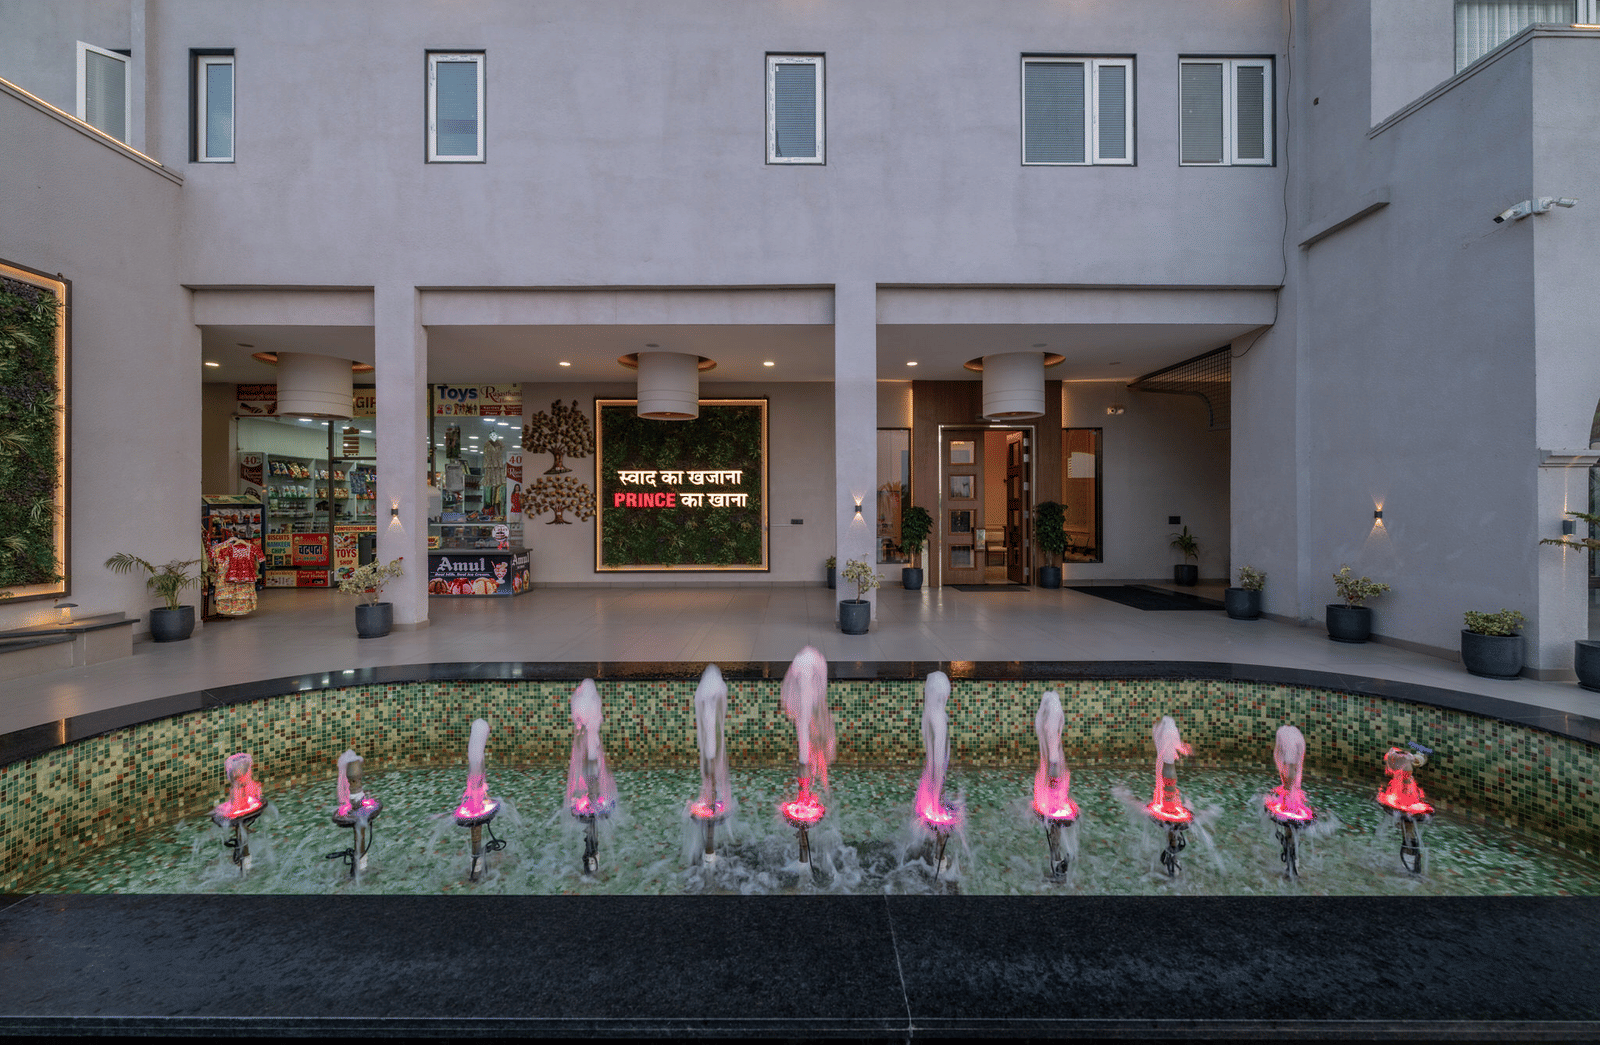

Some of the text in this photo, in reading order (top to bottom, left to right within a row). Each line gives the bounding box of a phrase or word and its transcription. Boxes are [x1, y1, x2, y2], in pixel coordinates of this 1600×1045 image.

[356, 396, 377, 409] GIF
[437, 386, 478, 403] Toys
[617, 470, 743, 487] स्वाद का खजाना
[614, 492, 749, 508] PRINCE का खाना
[298, 545, 322, 555] चटपटा
[336, 549, 357, 558] TOYS
[437, 556, 485, 572] Amul
